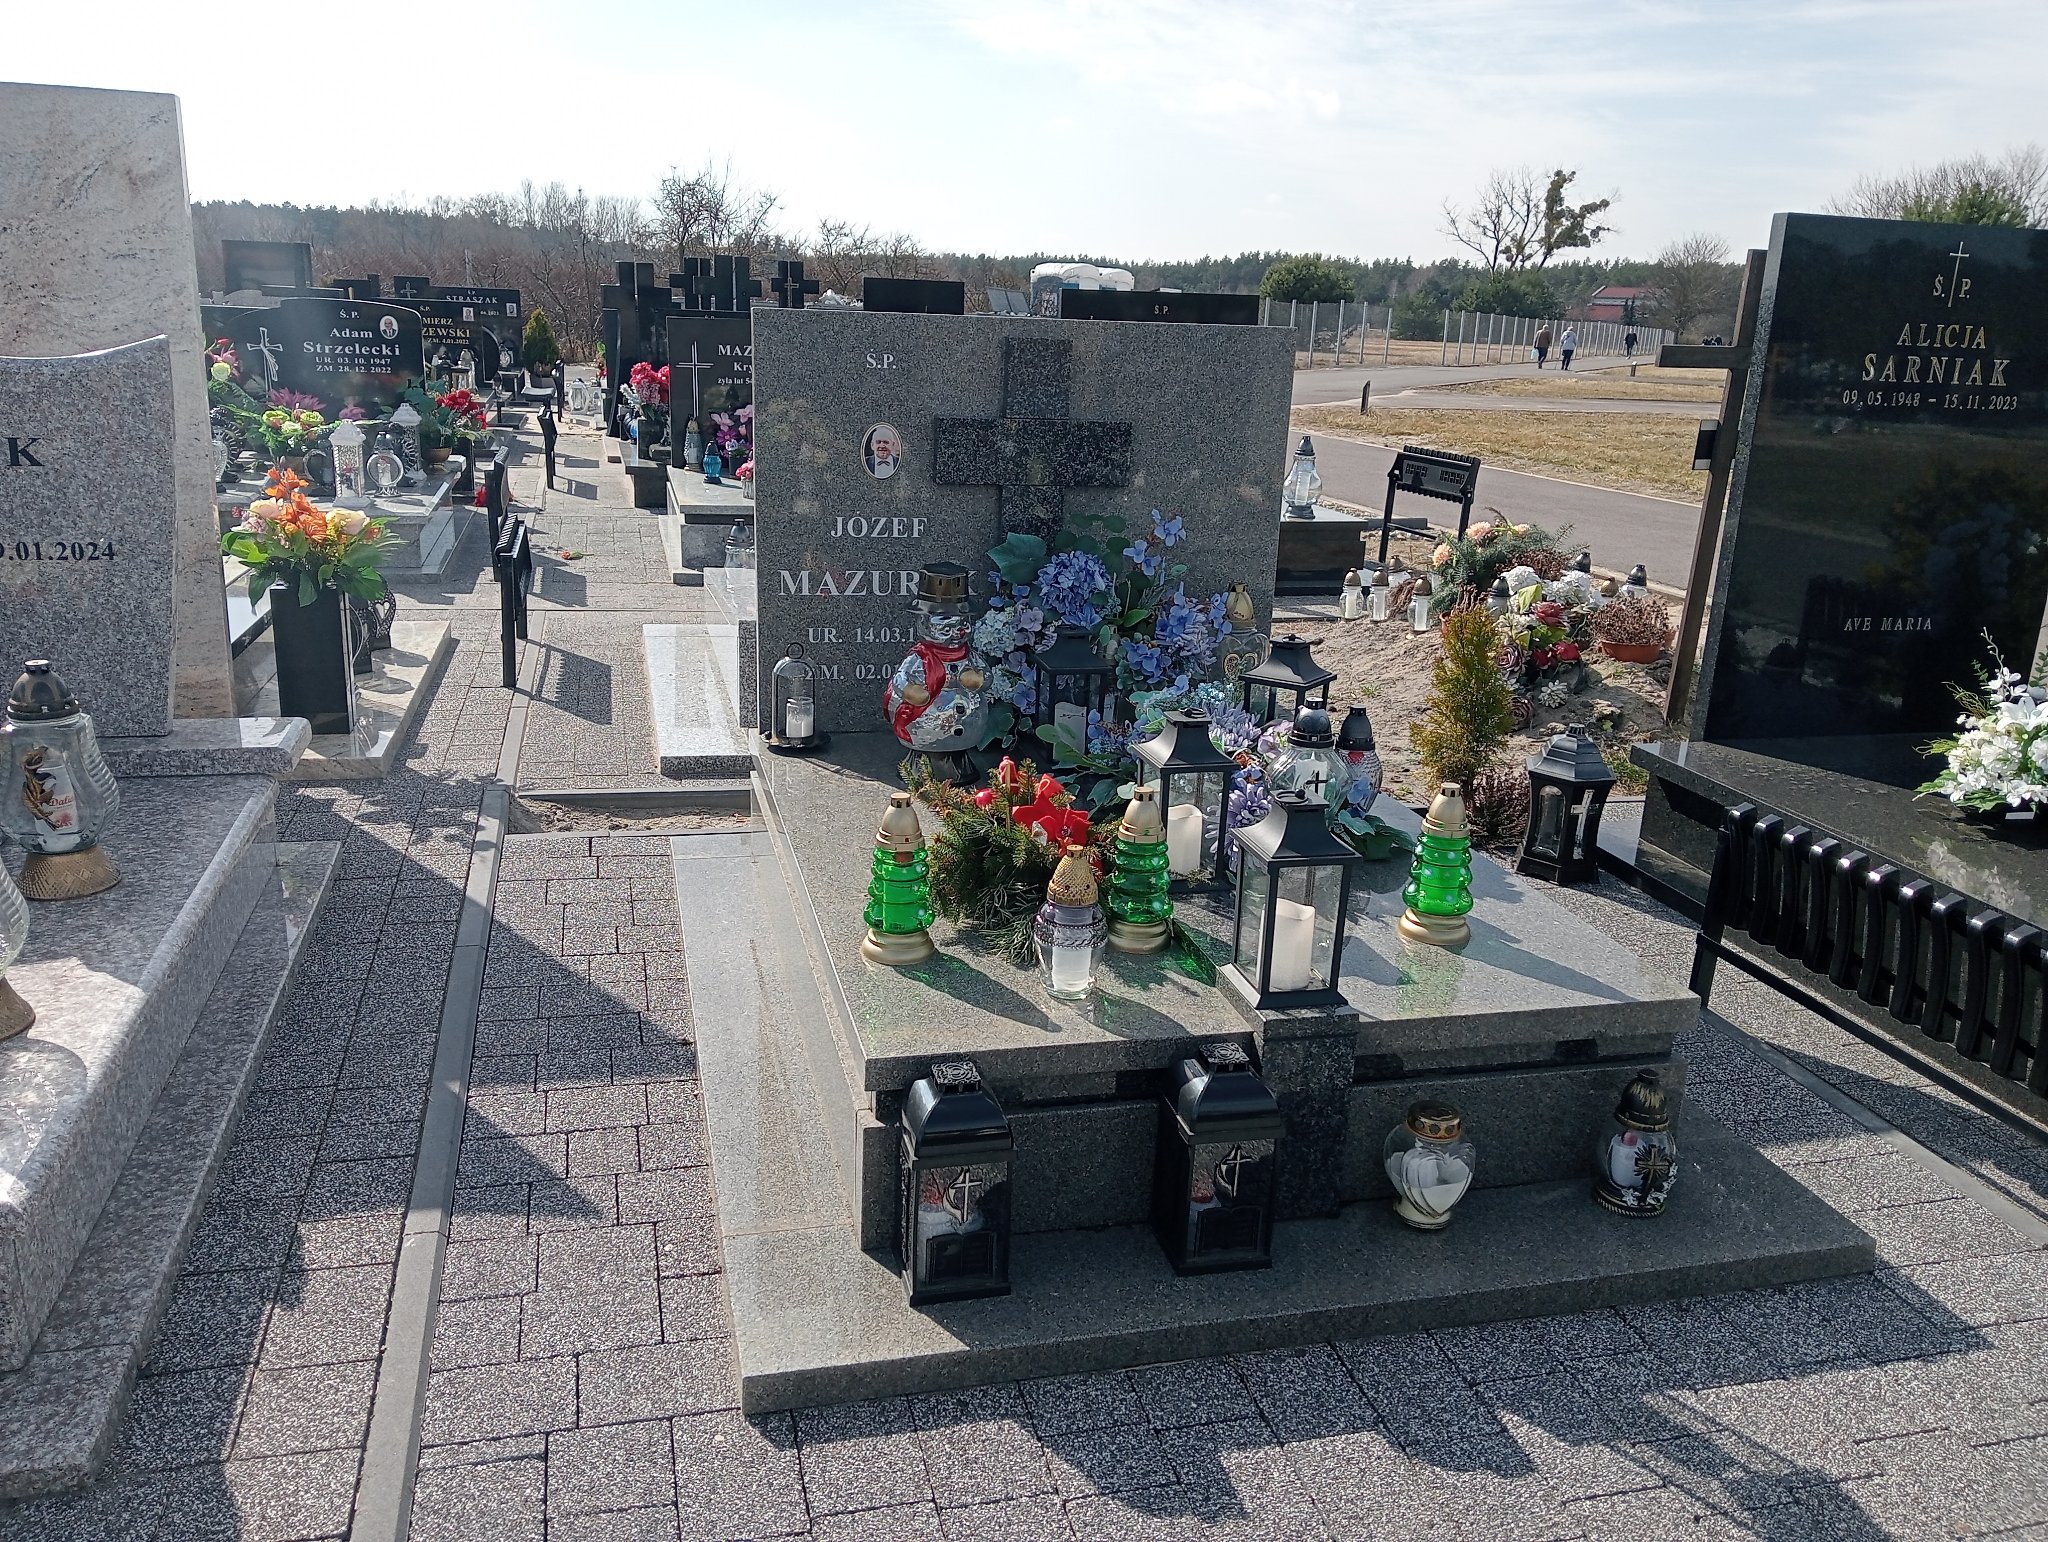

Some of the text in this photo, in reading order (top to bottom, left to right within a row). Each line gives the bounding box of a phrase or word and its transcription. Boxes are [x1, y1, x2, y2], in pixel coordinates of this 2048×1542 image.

[446, 295, 498, 304] STRASZAK
[330, 327, 373, 338] Adam
[1896, 322, 1987, 349] ALICJA
[303, 341, 400, 356] Strzelecki
[1862, 353, 2011, 386] SARNIAK
[831, 511, 928, 538] JÓZEF
[777, 570, 979, 596] MAZUR
[1843, 617, 1932, 631] AVE MARIA
[807, 627, 843, 643] UR.
